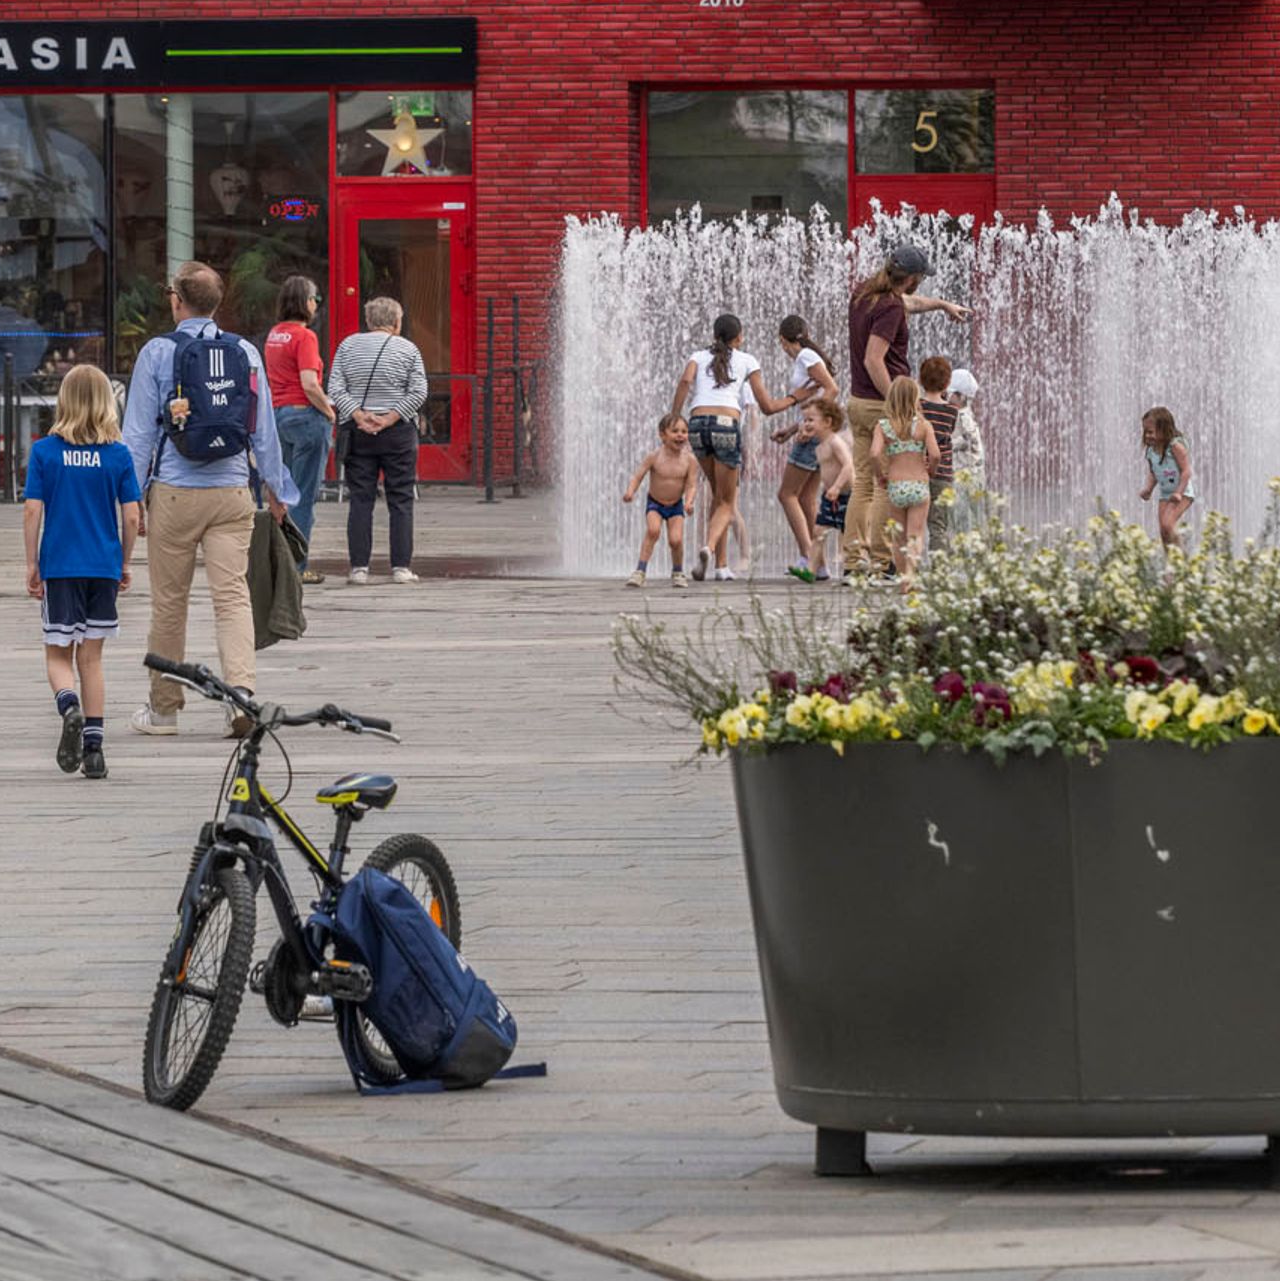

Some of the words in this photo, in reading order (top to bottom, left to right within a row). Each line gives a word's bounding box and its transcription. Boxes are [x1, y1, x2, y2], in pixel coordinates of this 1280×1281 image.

[911, 111, 938, 153] 5
[269, 201, 320, 219] OPEN
[62, 450, 101, 467] NORA
